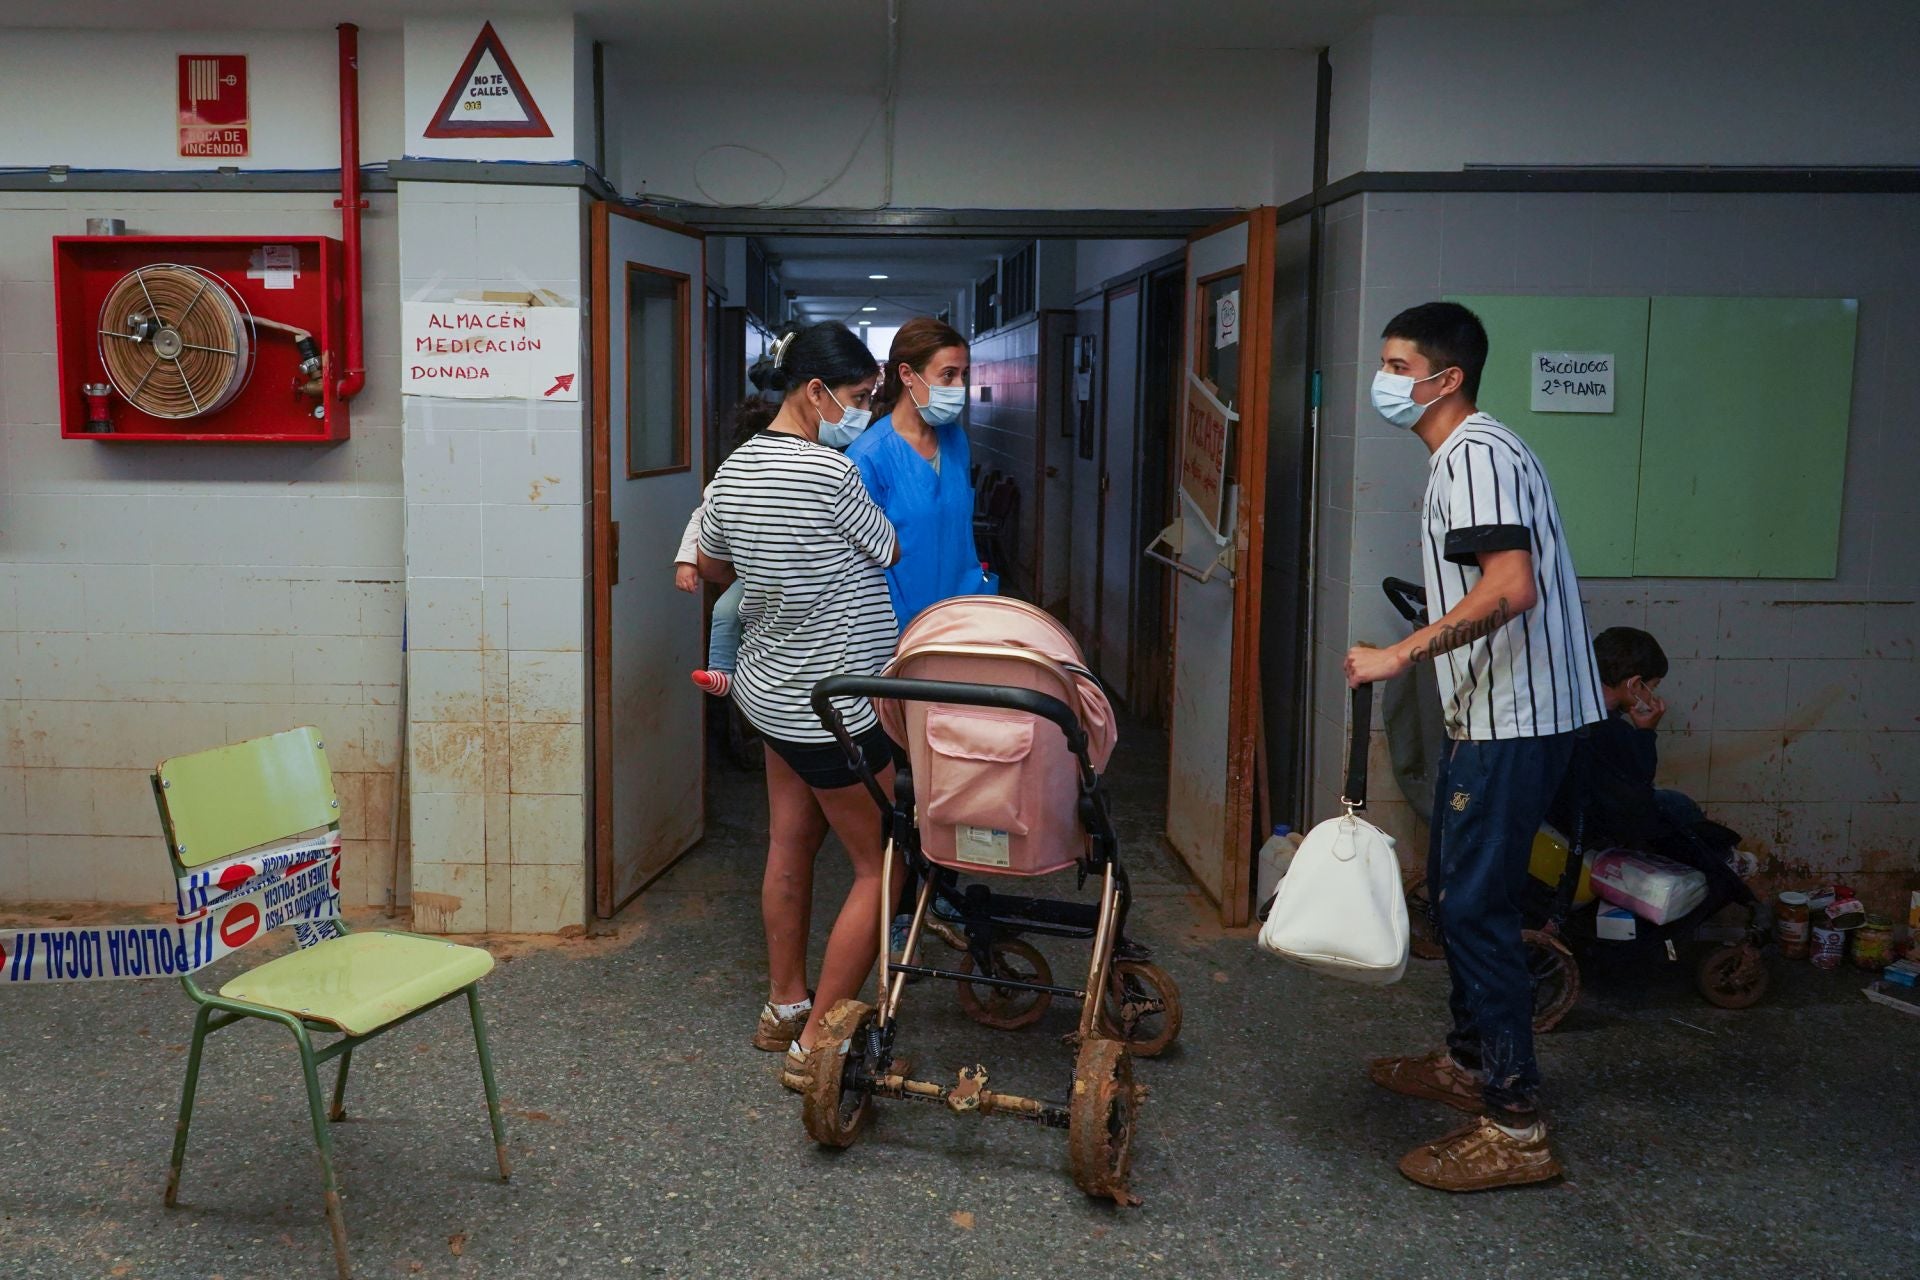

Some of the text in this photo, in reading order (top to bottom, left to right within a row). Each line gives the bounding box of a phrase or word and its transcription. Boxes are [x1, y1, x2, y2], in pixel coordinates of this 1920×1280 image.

[474, 74, 503, 85] NO TE
[470, 86, 509, 97] CALLES
[188, 131, 241, 142] BOCA DE
[185, 143, 243, 154] INCENDIO
[428, 311, 526, 330] ALMACÉN
[416, 336, 541, 353] MEDICACIÓN
[411, 365, 490, 380] DONADA
[1539, 357, 1608, 374] PSICÓLOGOS
[1563, 380, 1606, 396] PLANTA
[296, 872, 307, 894] DE
[307, 862, 329, 888] LINEA
[264, 878, 295, 909] POLICIA
[294, 882, 331, 916] PROHIBIDO
[265, 907, 284, 931] PASO
[284, 901, 294, 920] EL
[41, 928, 189, 979] POLICIA LOCAL
